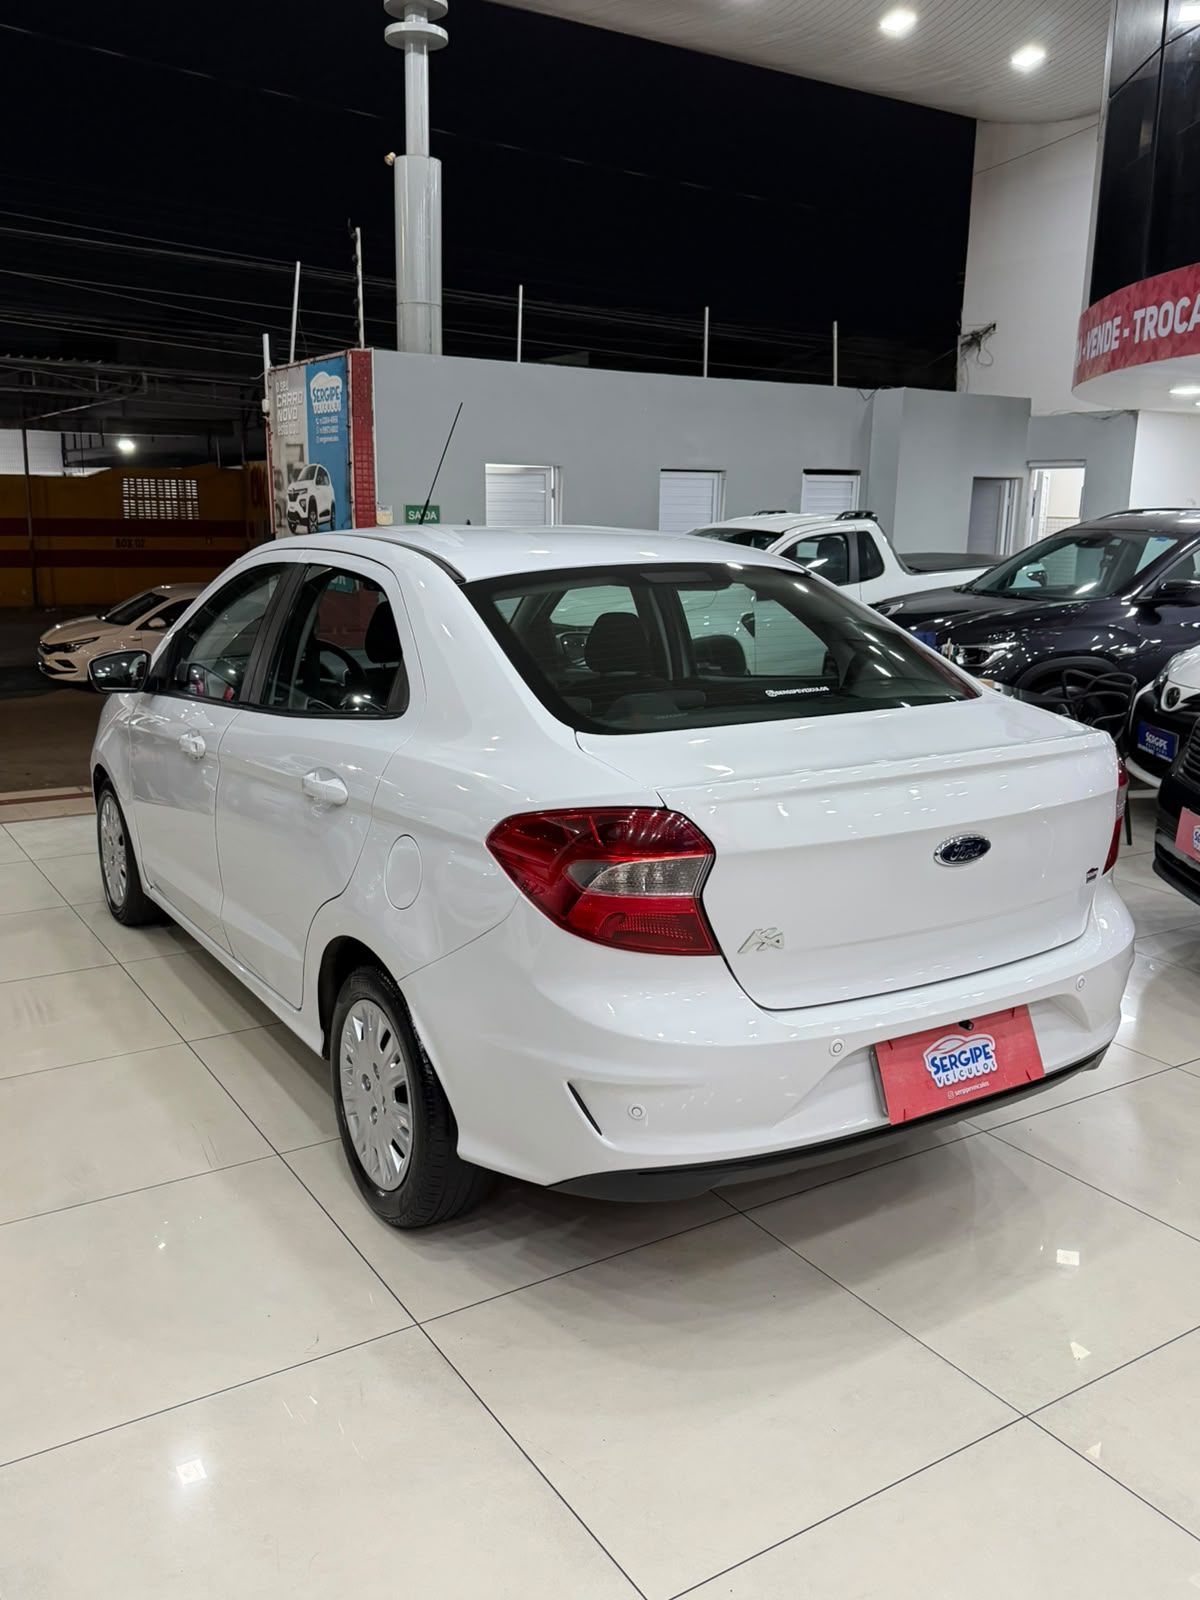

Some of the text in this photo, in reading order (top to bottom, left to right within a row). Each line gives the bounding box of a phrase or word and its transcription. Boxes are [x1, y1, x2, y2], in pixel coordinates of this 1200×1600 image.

[1086, 315, 1122, 361] VENDE
[1133, 293, 1200, 344] TROCA
[276, 391, 303, 408] CARRO
[312, 384, 341, 403] SERGIPE
[277, 407, 298, 422] NOVO
[408, 508, 438, 521] SADA
[949, 841, 982, 861] Ford
[930, 1043, 993, 1076] SERGIPE
